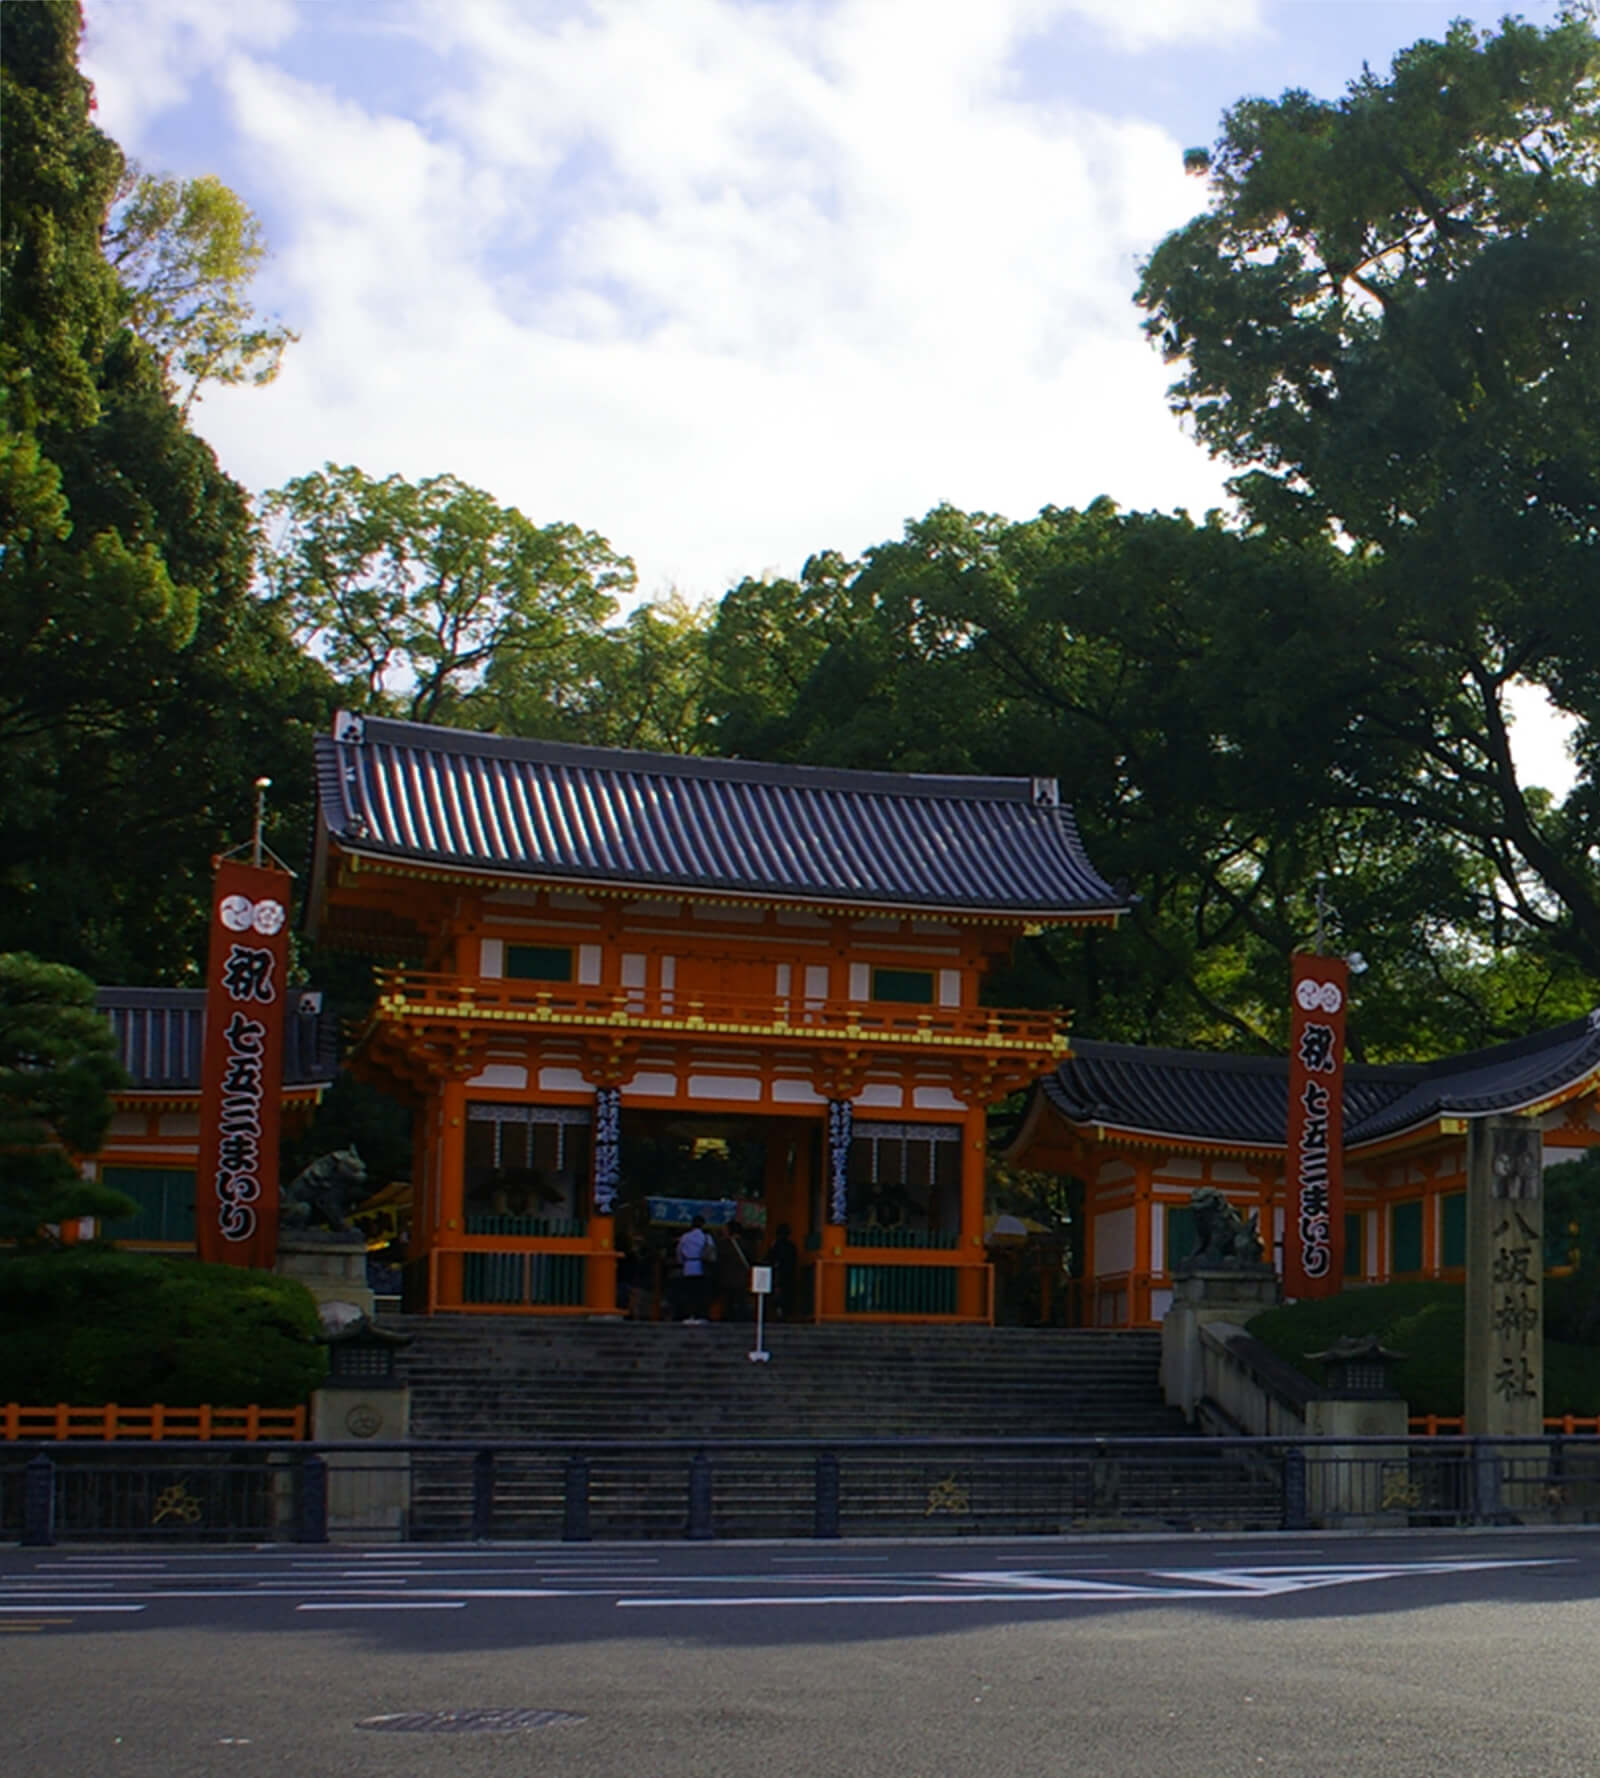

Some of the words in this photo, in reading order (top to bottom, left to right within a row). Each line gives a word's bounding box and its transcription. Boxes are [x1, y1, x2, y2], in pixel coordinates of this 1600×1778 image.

[223, 946, 275, 1002] 祝
[1300, 1023, 1335, 1073] 祝
[217, 1013, 266, 1241] 七五三まいり
[1301, 1082, 1330, 1278] 七五三まいり
[1493, 1211, 1539, 1401] 八坂神社
